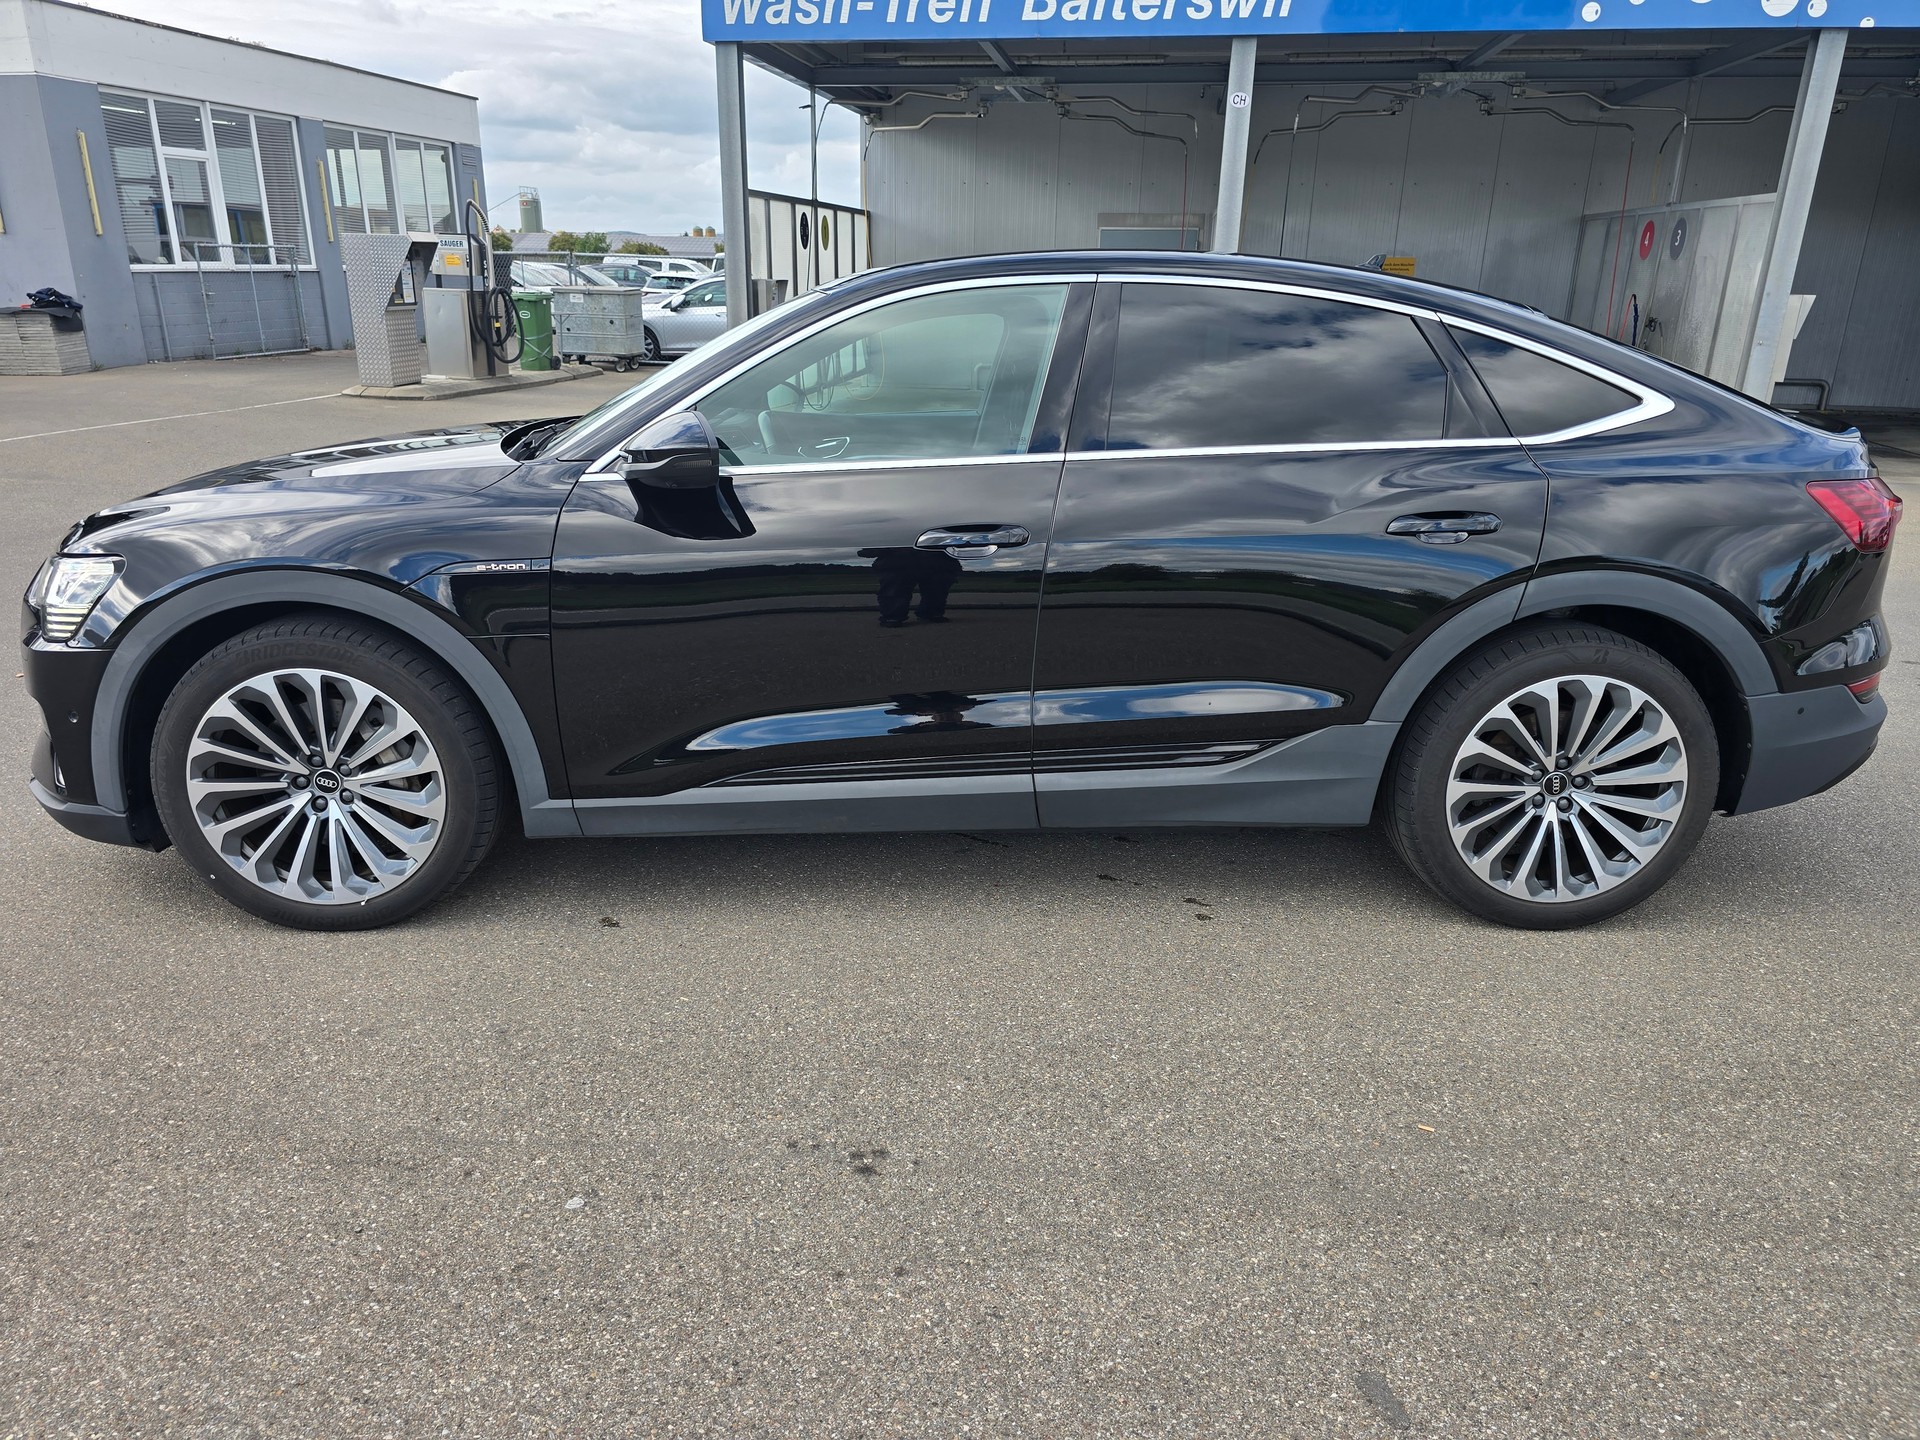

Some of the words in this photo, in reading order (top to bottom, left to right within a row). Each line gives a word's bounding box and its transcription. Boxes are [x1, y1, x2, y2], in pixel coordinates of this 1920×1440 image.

[1232, 94, 1247, 106] CH
[440, 239, 464, 247] SAUGER
[1644, 231, 1650, 247] 4
[1674, 229, 1682, 246] 3
[476, 563, 526, 571] e-tron
[235, 643, 368, 667] BRIDGESTONE
